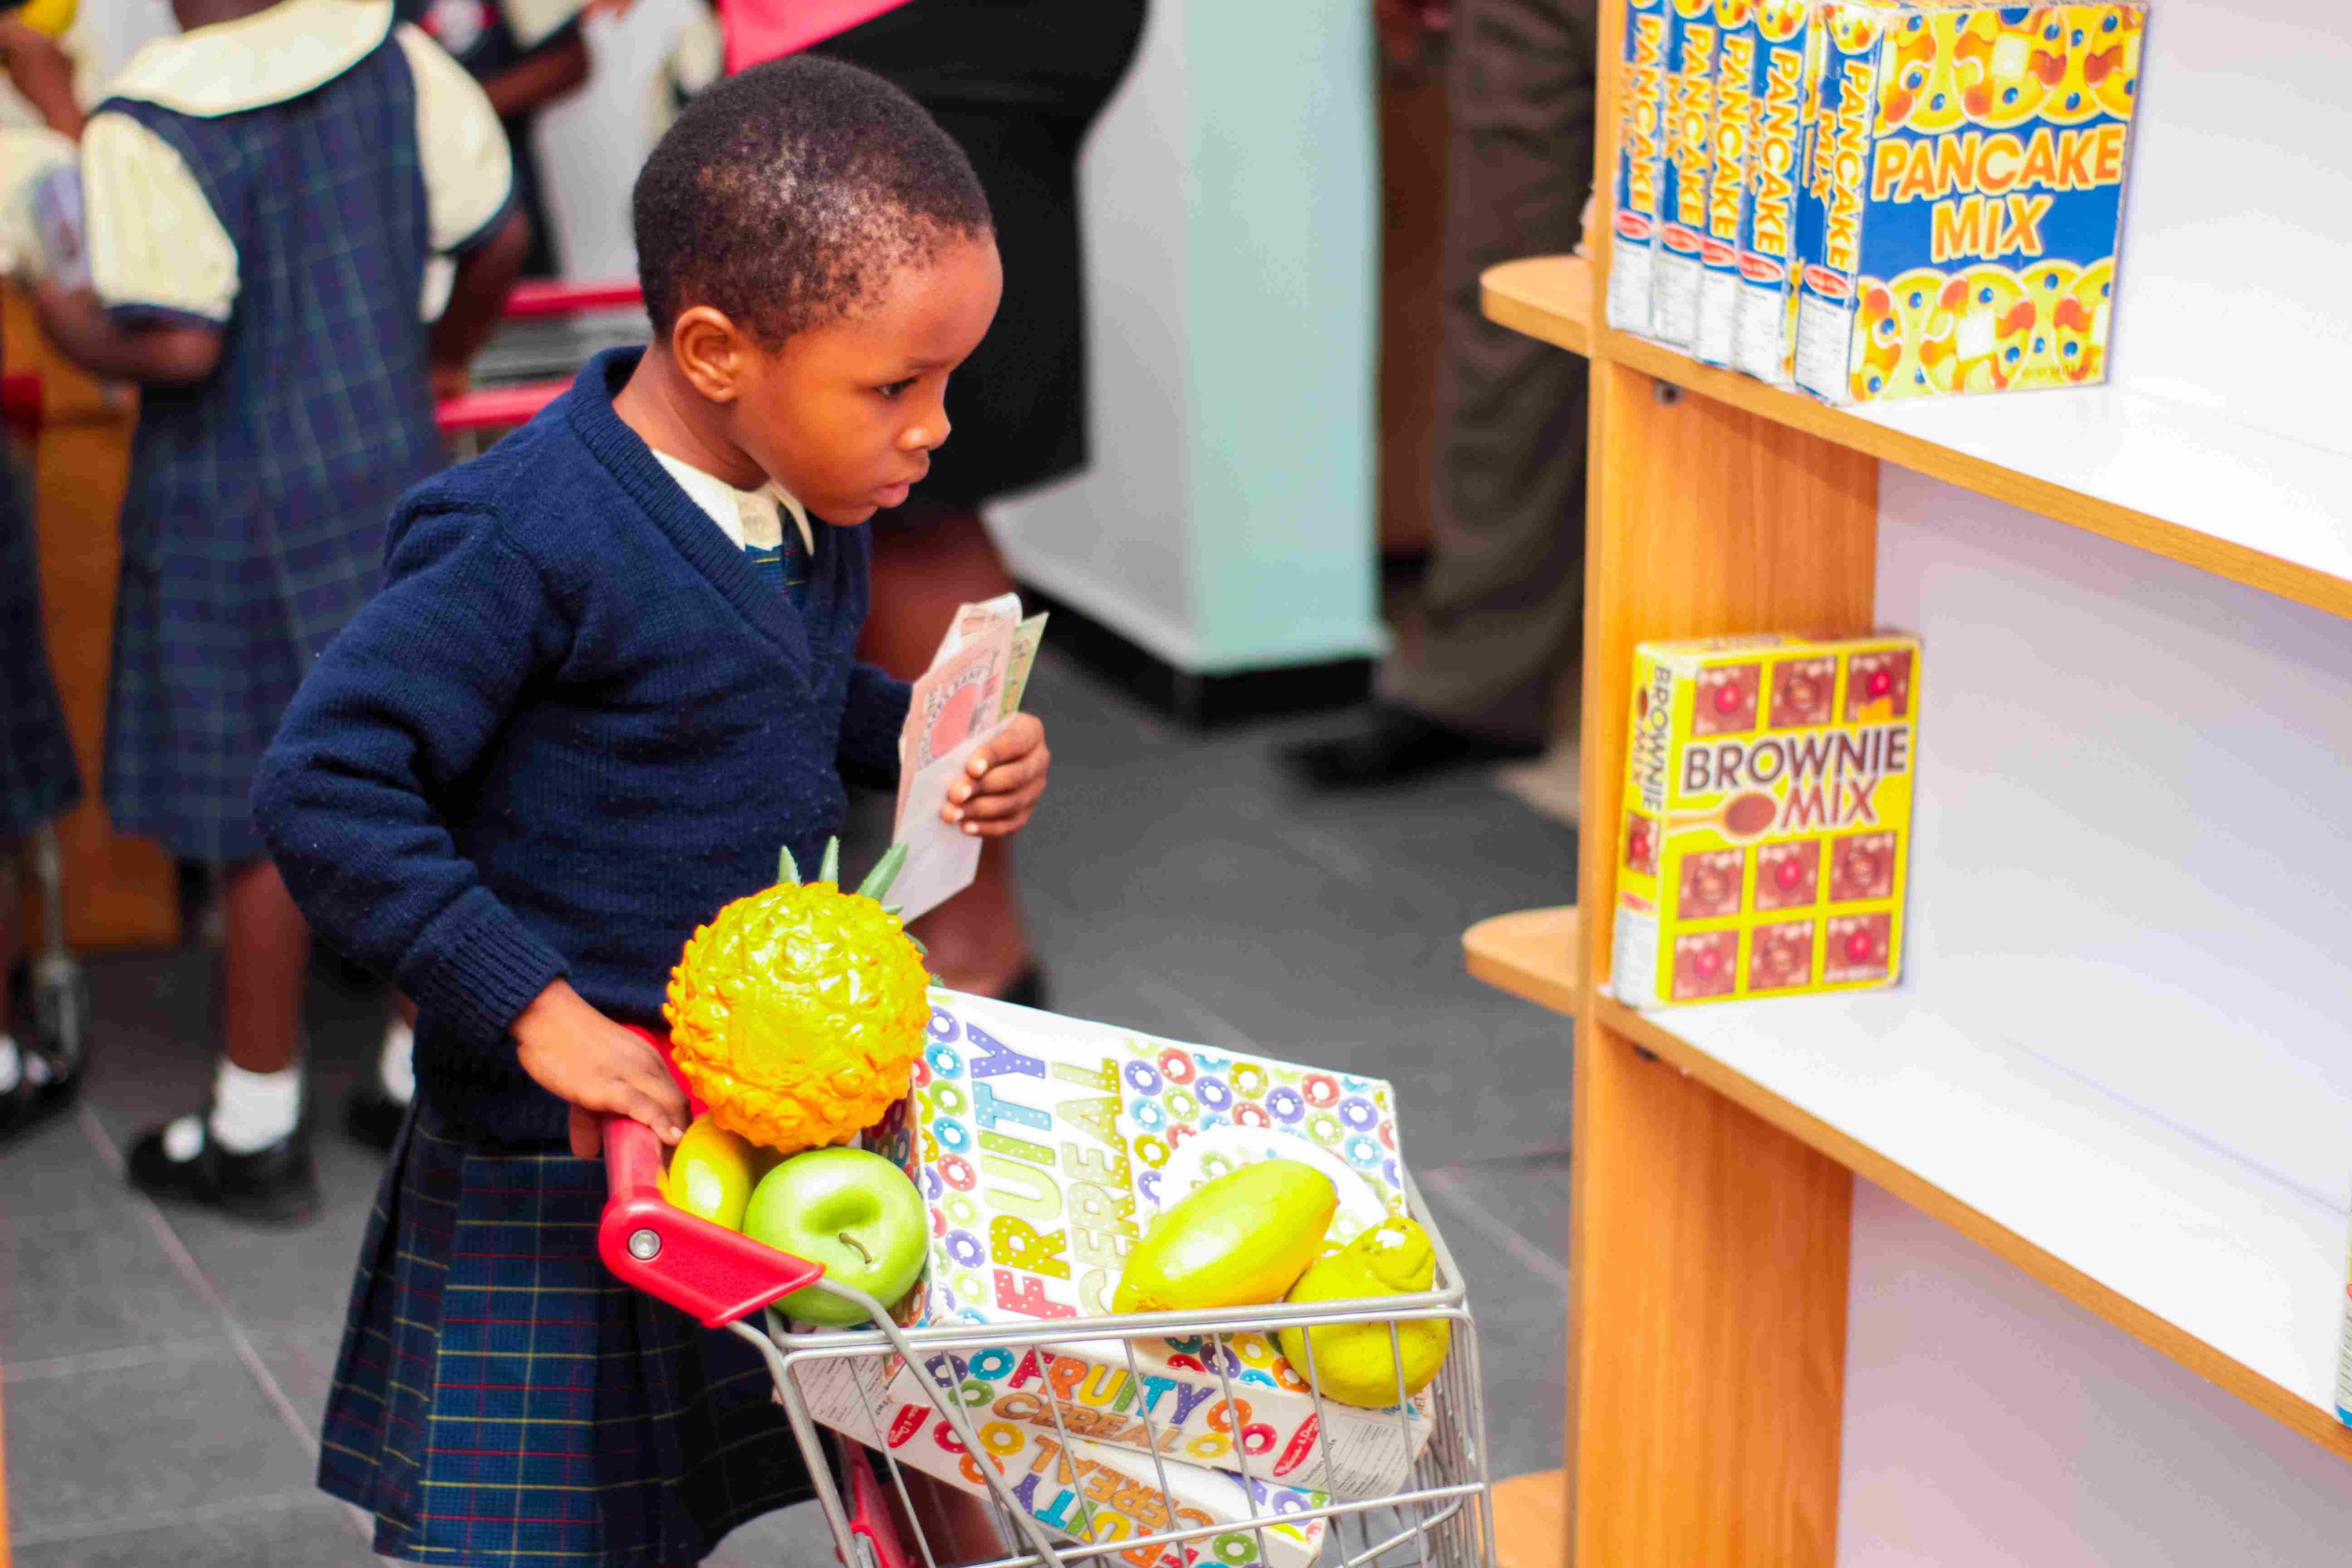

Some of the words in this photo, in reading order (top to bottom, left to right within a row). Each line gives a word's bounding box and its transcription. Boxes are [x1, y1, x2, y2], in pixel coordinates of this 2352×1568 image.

[1630, 14, 1663, 213] PANCAKE
[1679, 24, 1714, 227] PANCAKE
[1711, 34, 1754, 240] PANCAKE
[1755, 48, 1802, 256] PANCAKE
[1811, 109, 1836, 208] MIX
[1827, 60, 1874, 272] PANCAKE
[1872, 124, 2127, 202] PANCAKE
[1932, 193, 2052, 262] MIX
[1643, 665, 1672, 811] BROWNIE
[1684, 727, 1908, 792] BROWNIE
[1781, 777, 1877, 829] MIX
[966, 1022, 1077, 1318] FRUITY
[1051, 1057, 1141, 1315] CEREAL
[992, 1392, 1181, 1452] CEREAL
[1008, 1349, 1216, 1425] FRUITY
